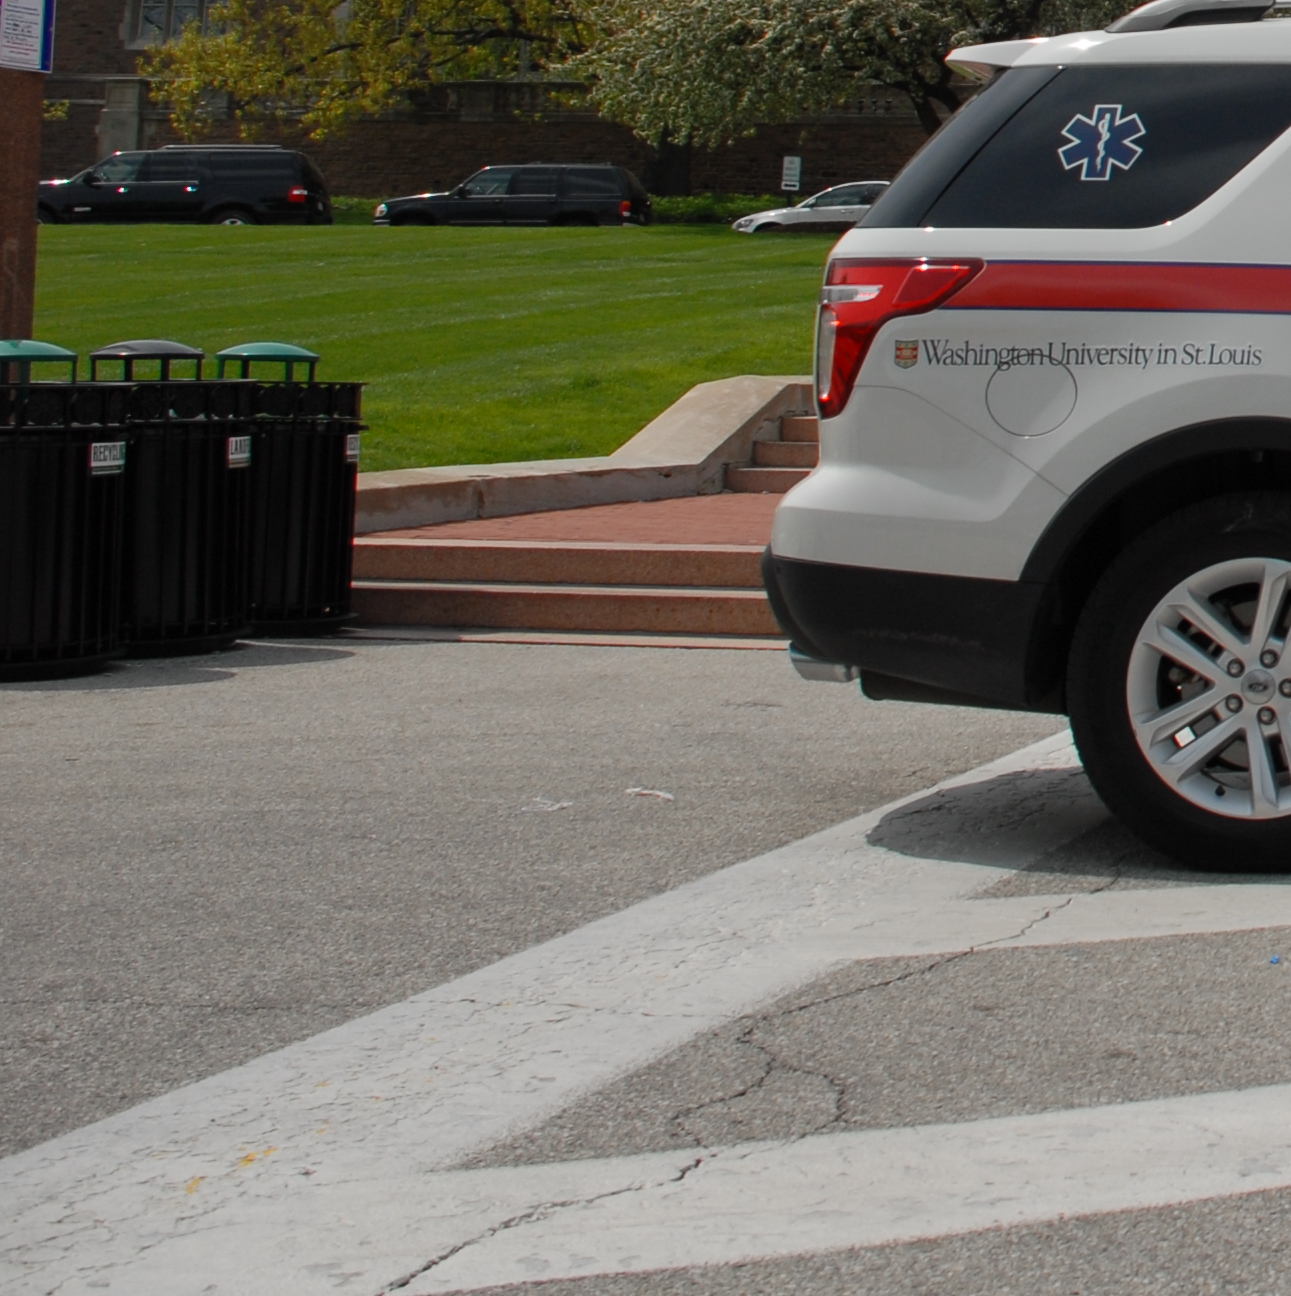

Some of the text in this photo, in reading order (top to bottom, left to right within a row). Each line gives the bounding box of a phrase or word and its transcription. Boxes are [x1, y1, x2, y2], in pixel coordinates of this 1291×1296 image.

[921, 339, 1046, 371] Washington
[1048, 341, 1152, 370] University
[1157, 343, 1177, 366] in
